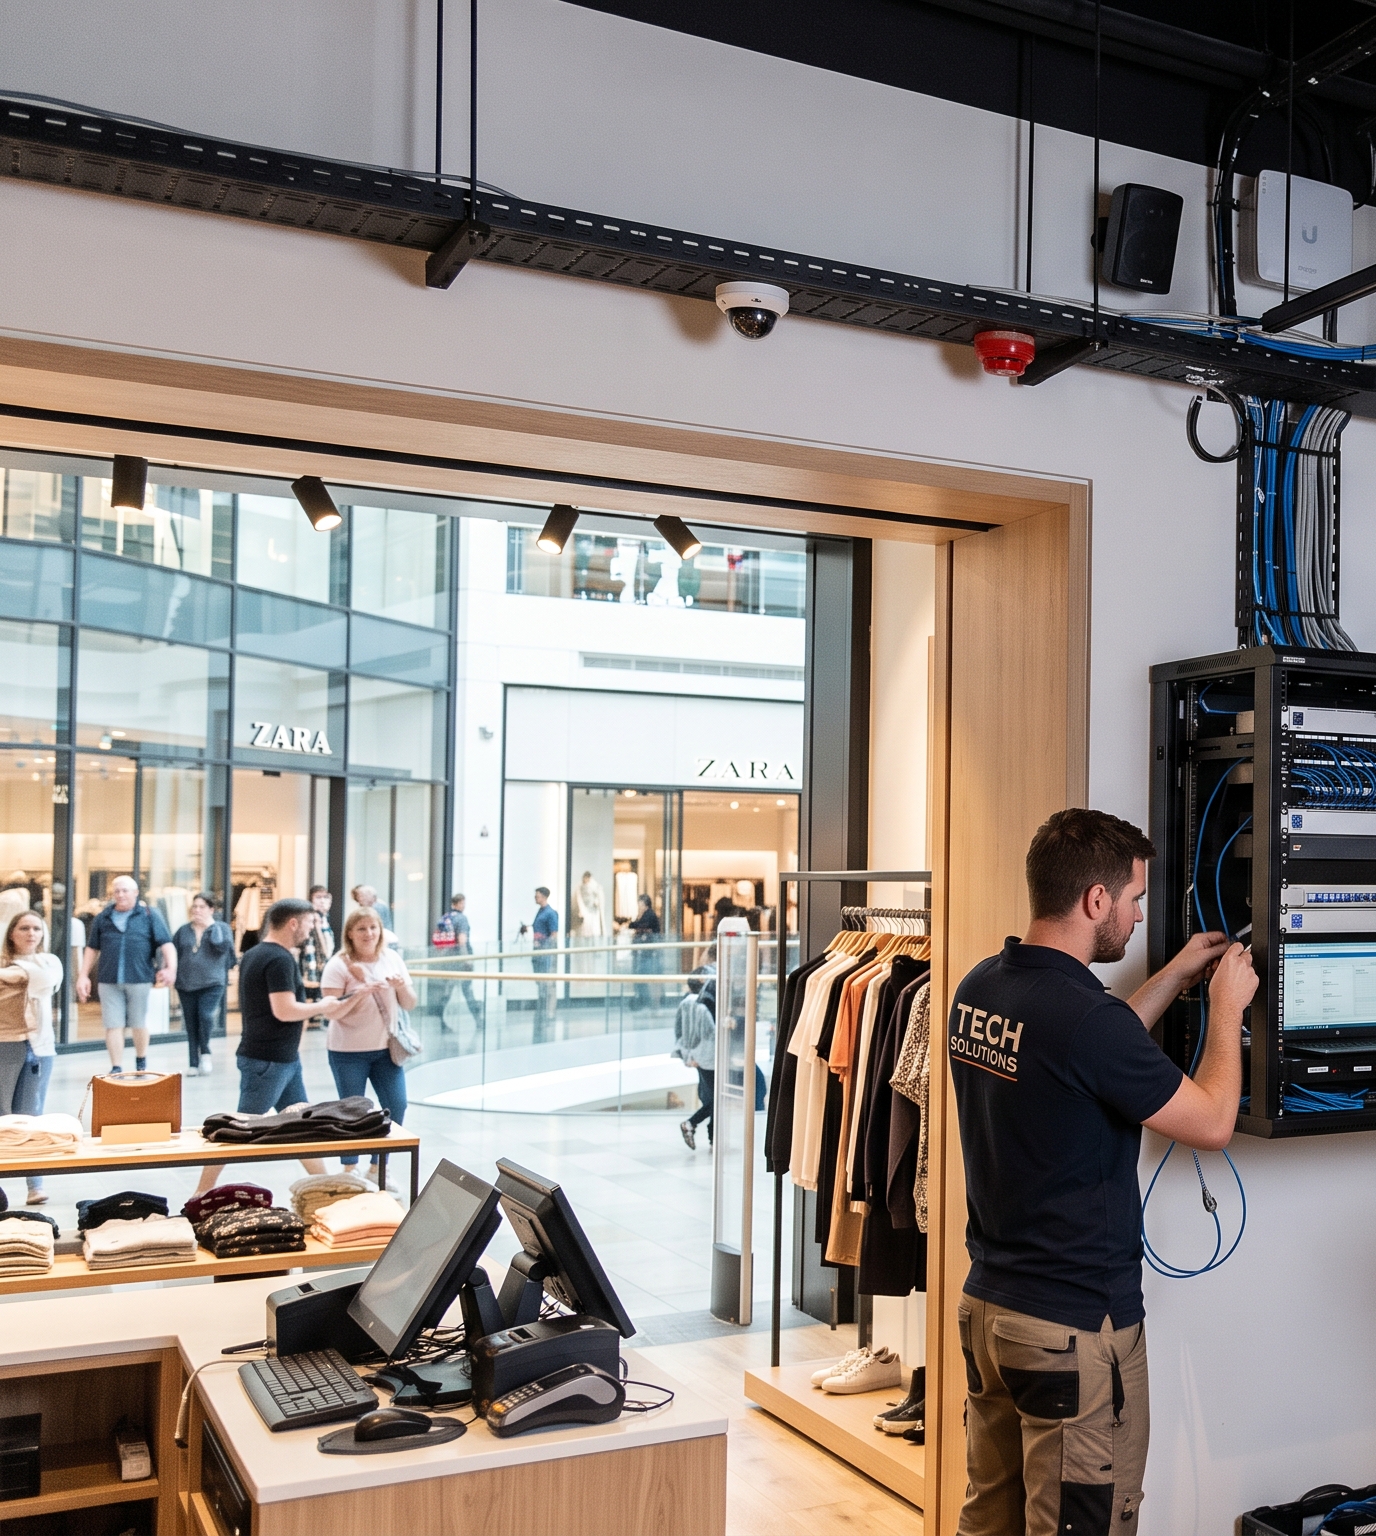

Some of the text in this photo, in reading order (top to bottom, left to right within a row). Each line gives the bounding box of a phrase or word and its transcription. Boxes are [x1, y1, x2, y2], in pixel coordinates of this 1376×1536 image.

[251, 721, 333, 755] ZARA
[697, 759, 794, 780] ZARA
[957, 1002, 1024, 1053] TECH
[950, 1035, 1018, 1073] SOLUTIONS
